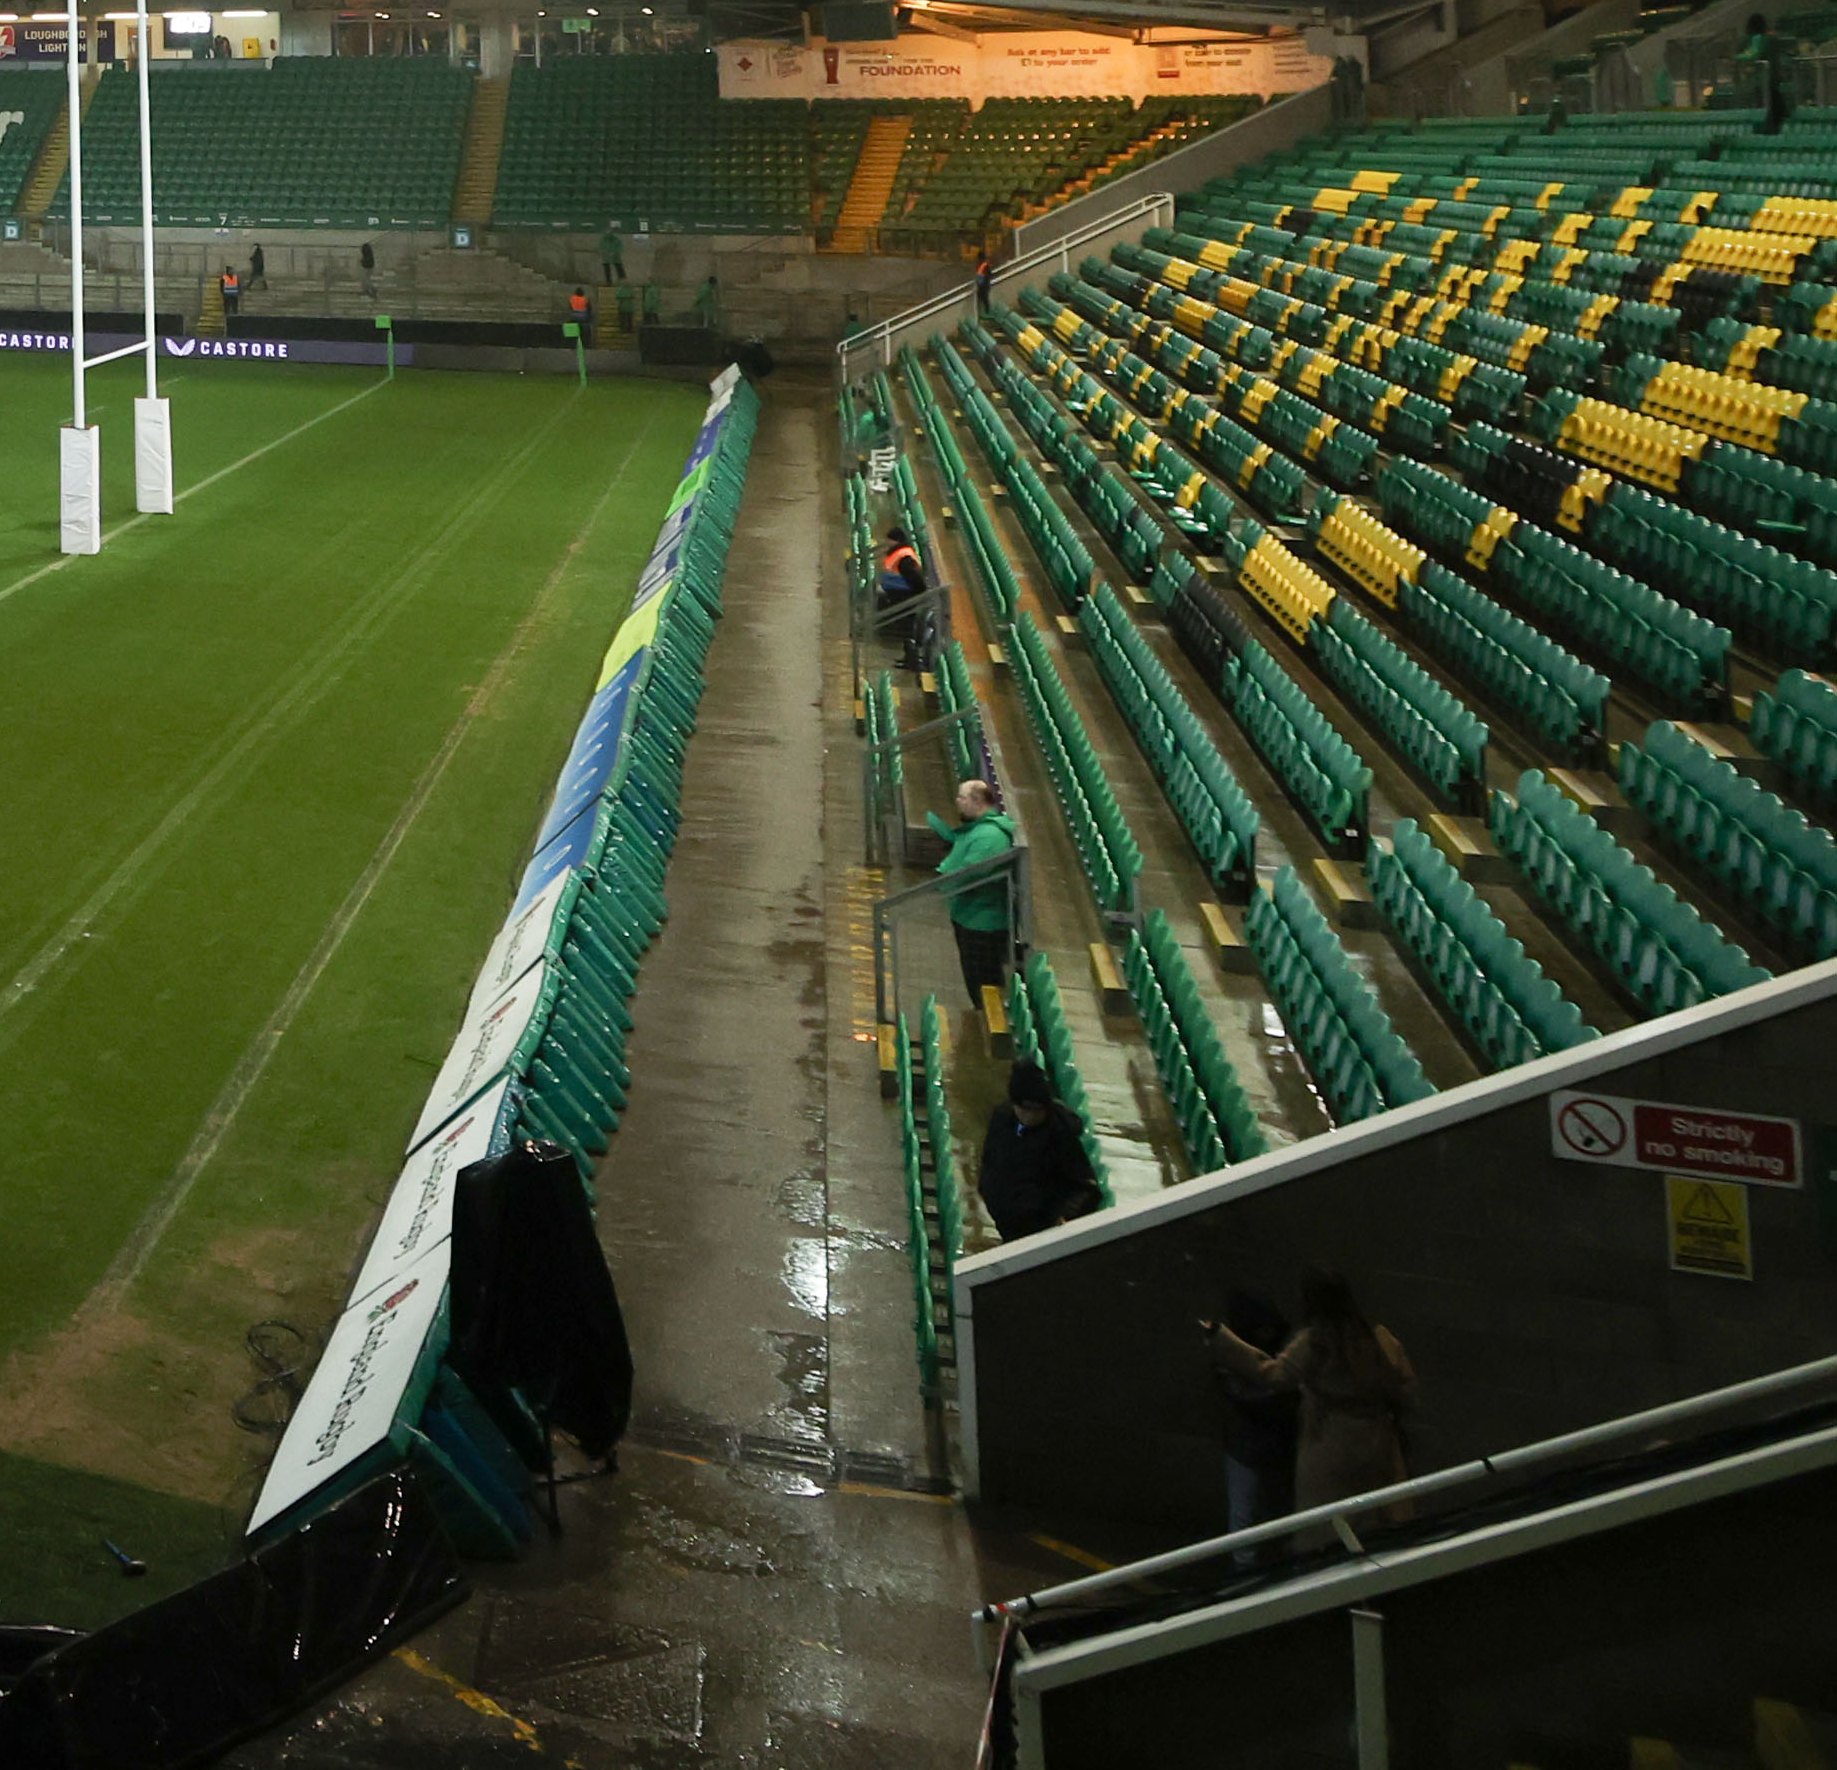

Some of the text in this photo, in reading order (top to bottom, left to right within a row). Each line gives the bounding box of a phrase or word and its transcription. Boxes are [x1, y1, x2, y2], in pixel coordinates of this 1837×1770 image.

[859, 65, 962, 77] FOUNDATION
[200, 341, 288, 358] CASTORE
[1671, 1116, 1755, 1147] Strictly
[1644, 1140, 1786, 1176] no smoking
